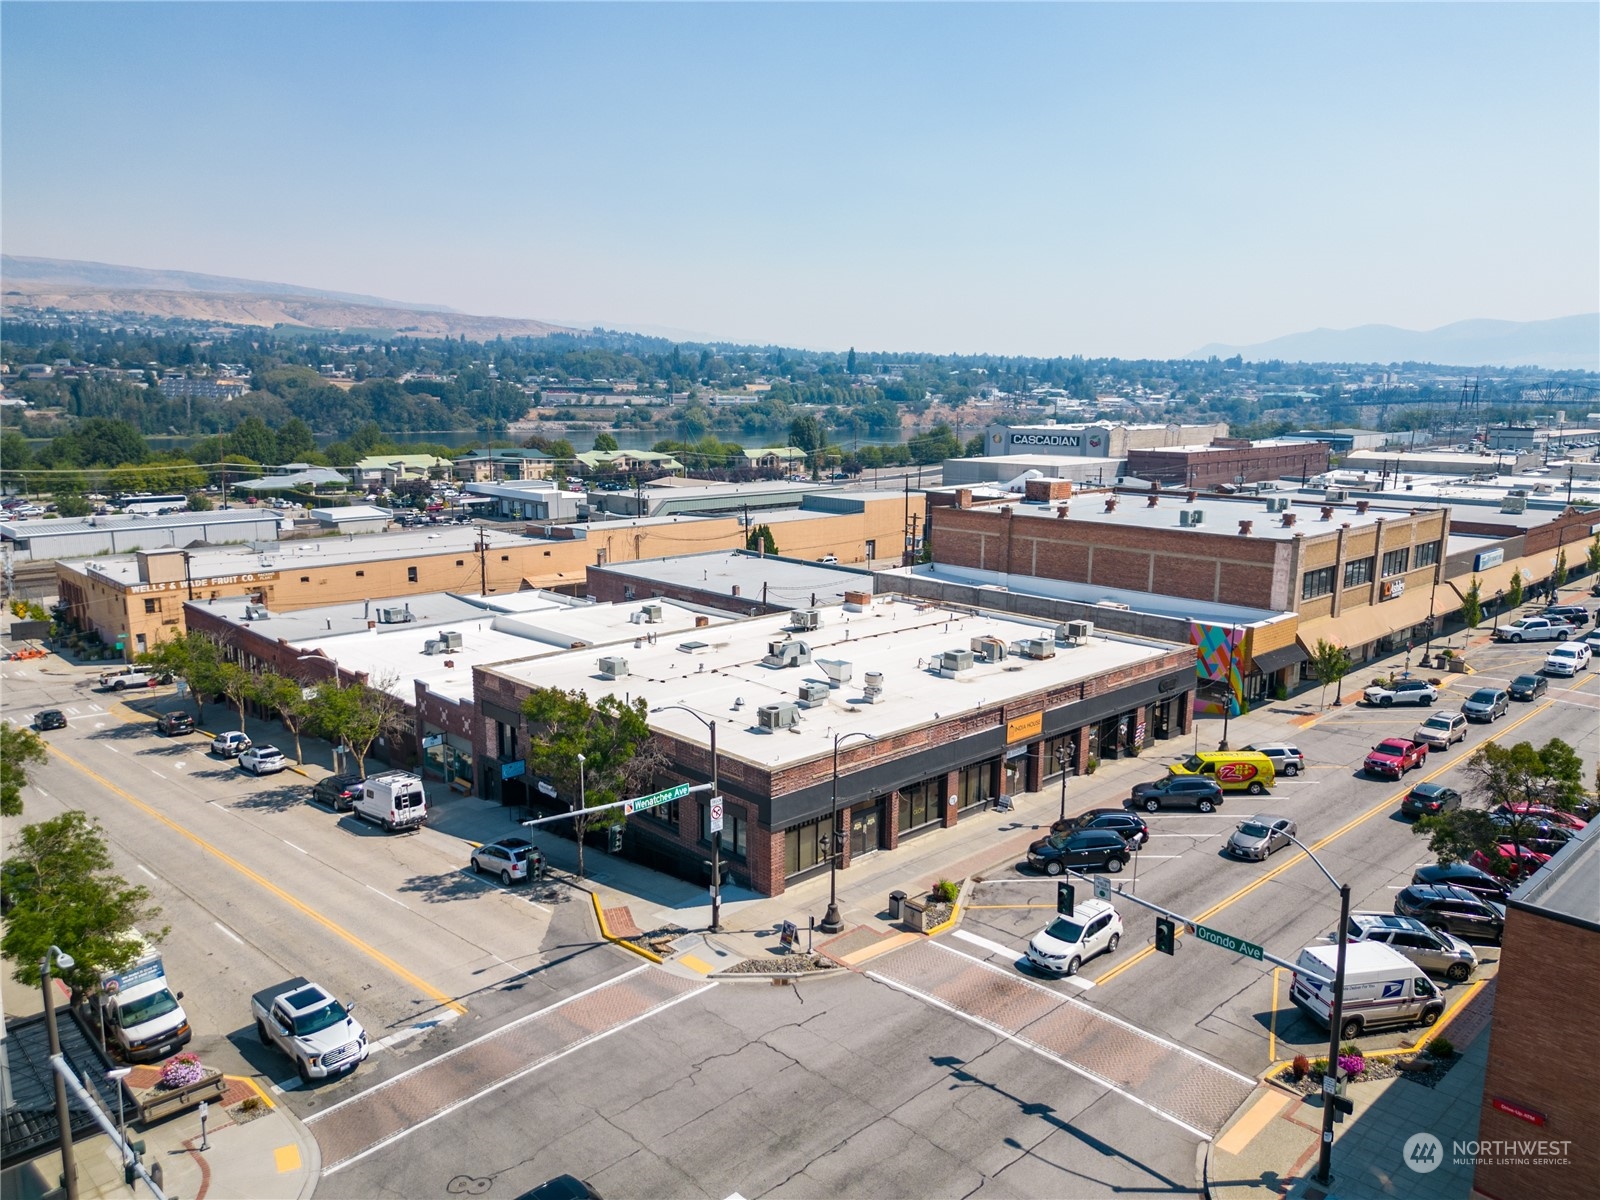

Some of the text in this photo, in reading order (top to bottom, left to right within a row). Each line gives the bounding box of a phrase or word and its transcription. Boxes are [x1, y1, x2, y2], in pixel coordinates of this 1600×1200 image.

[1013, 434, 1078, 446] CASCADIAN
[130, 583, 166, 594] WELLS
[169, 582, 176, 590] &
[211, 575, 238, 586] FRUIT
[241, 574, 256, 582] CO.
[1014, 724, 1027, 733] INDIA
[634, 786, 688, 810] Wenatchee Ave
[1198, 927, 1261, 959] Orondo Ave
